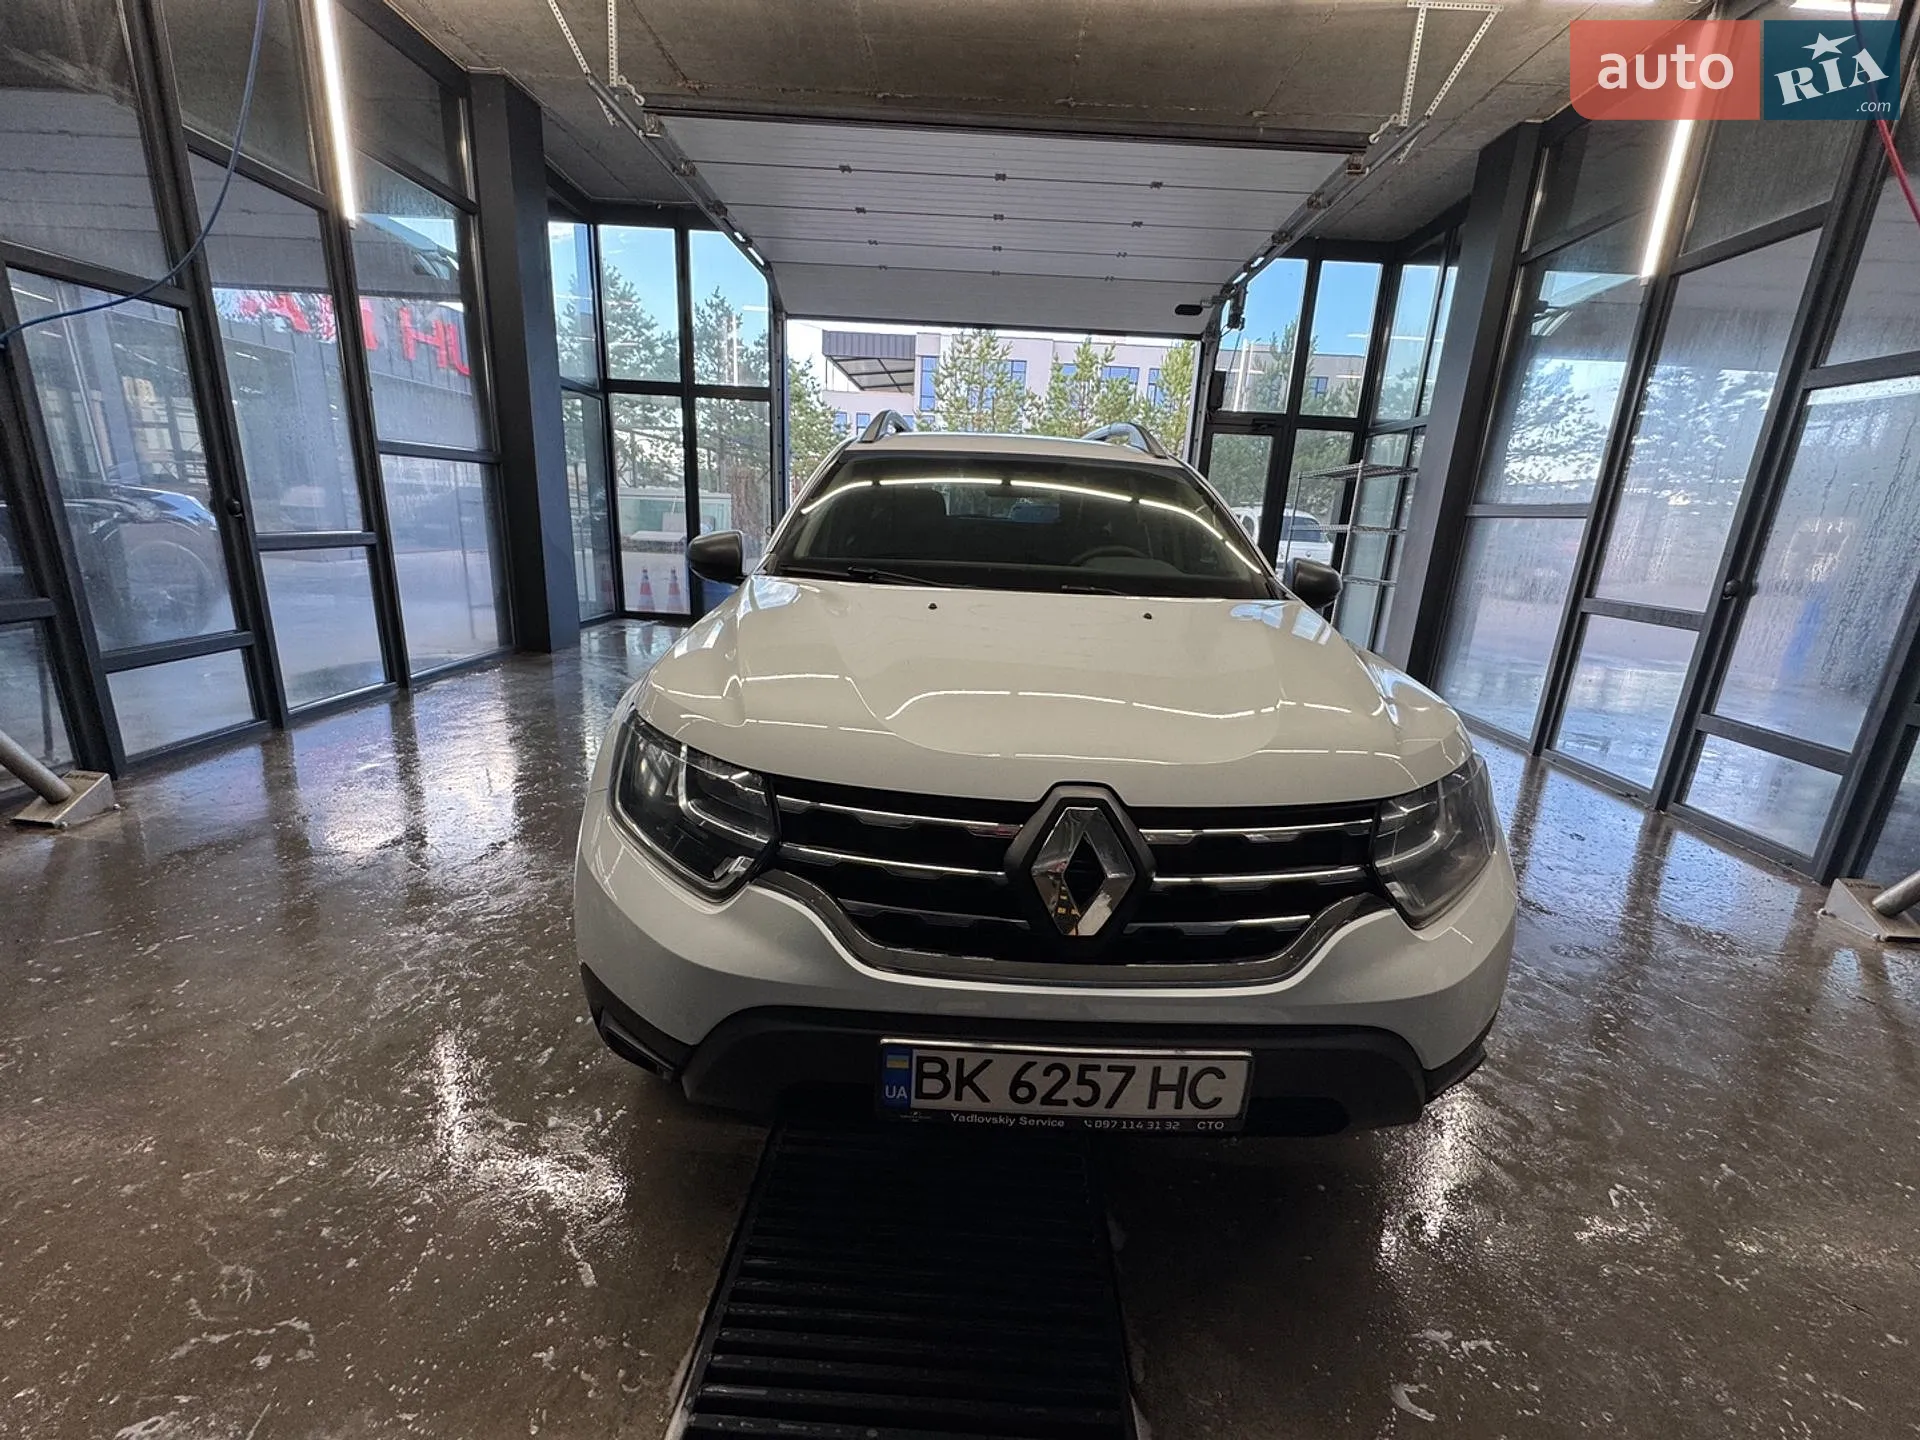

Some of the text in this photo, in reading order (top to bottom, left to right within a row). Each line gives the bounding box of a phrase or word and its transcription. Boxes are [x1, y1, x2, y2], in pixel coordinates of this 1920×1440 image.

[915, 1055, 1227, 1110] BK 6257 HC
[885, 1084, 908, 1100] UA
[950, 1113, 1065, 1128] Yadlovskiy Service
[1094, 1119, 1118, 1129] 097
[1147, 1120, 1160, 1130] 31
[1164, 1120, 1180, 1130] 32
